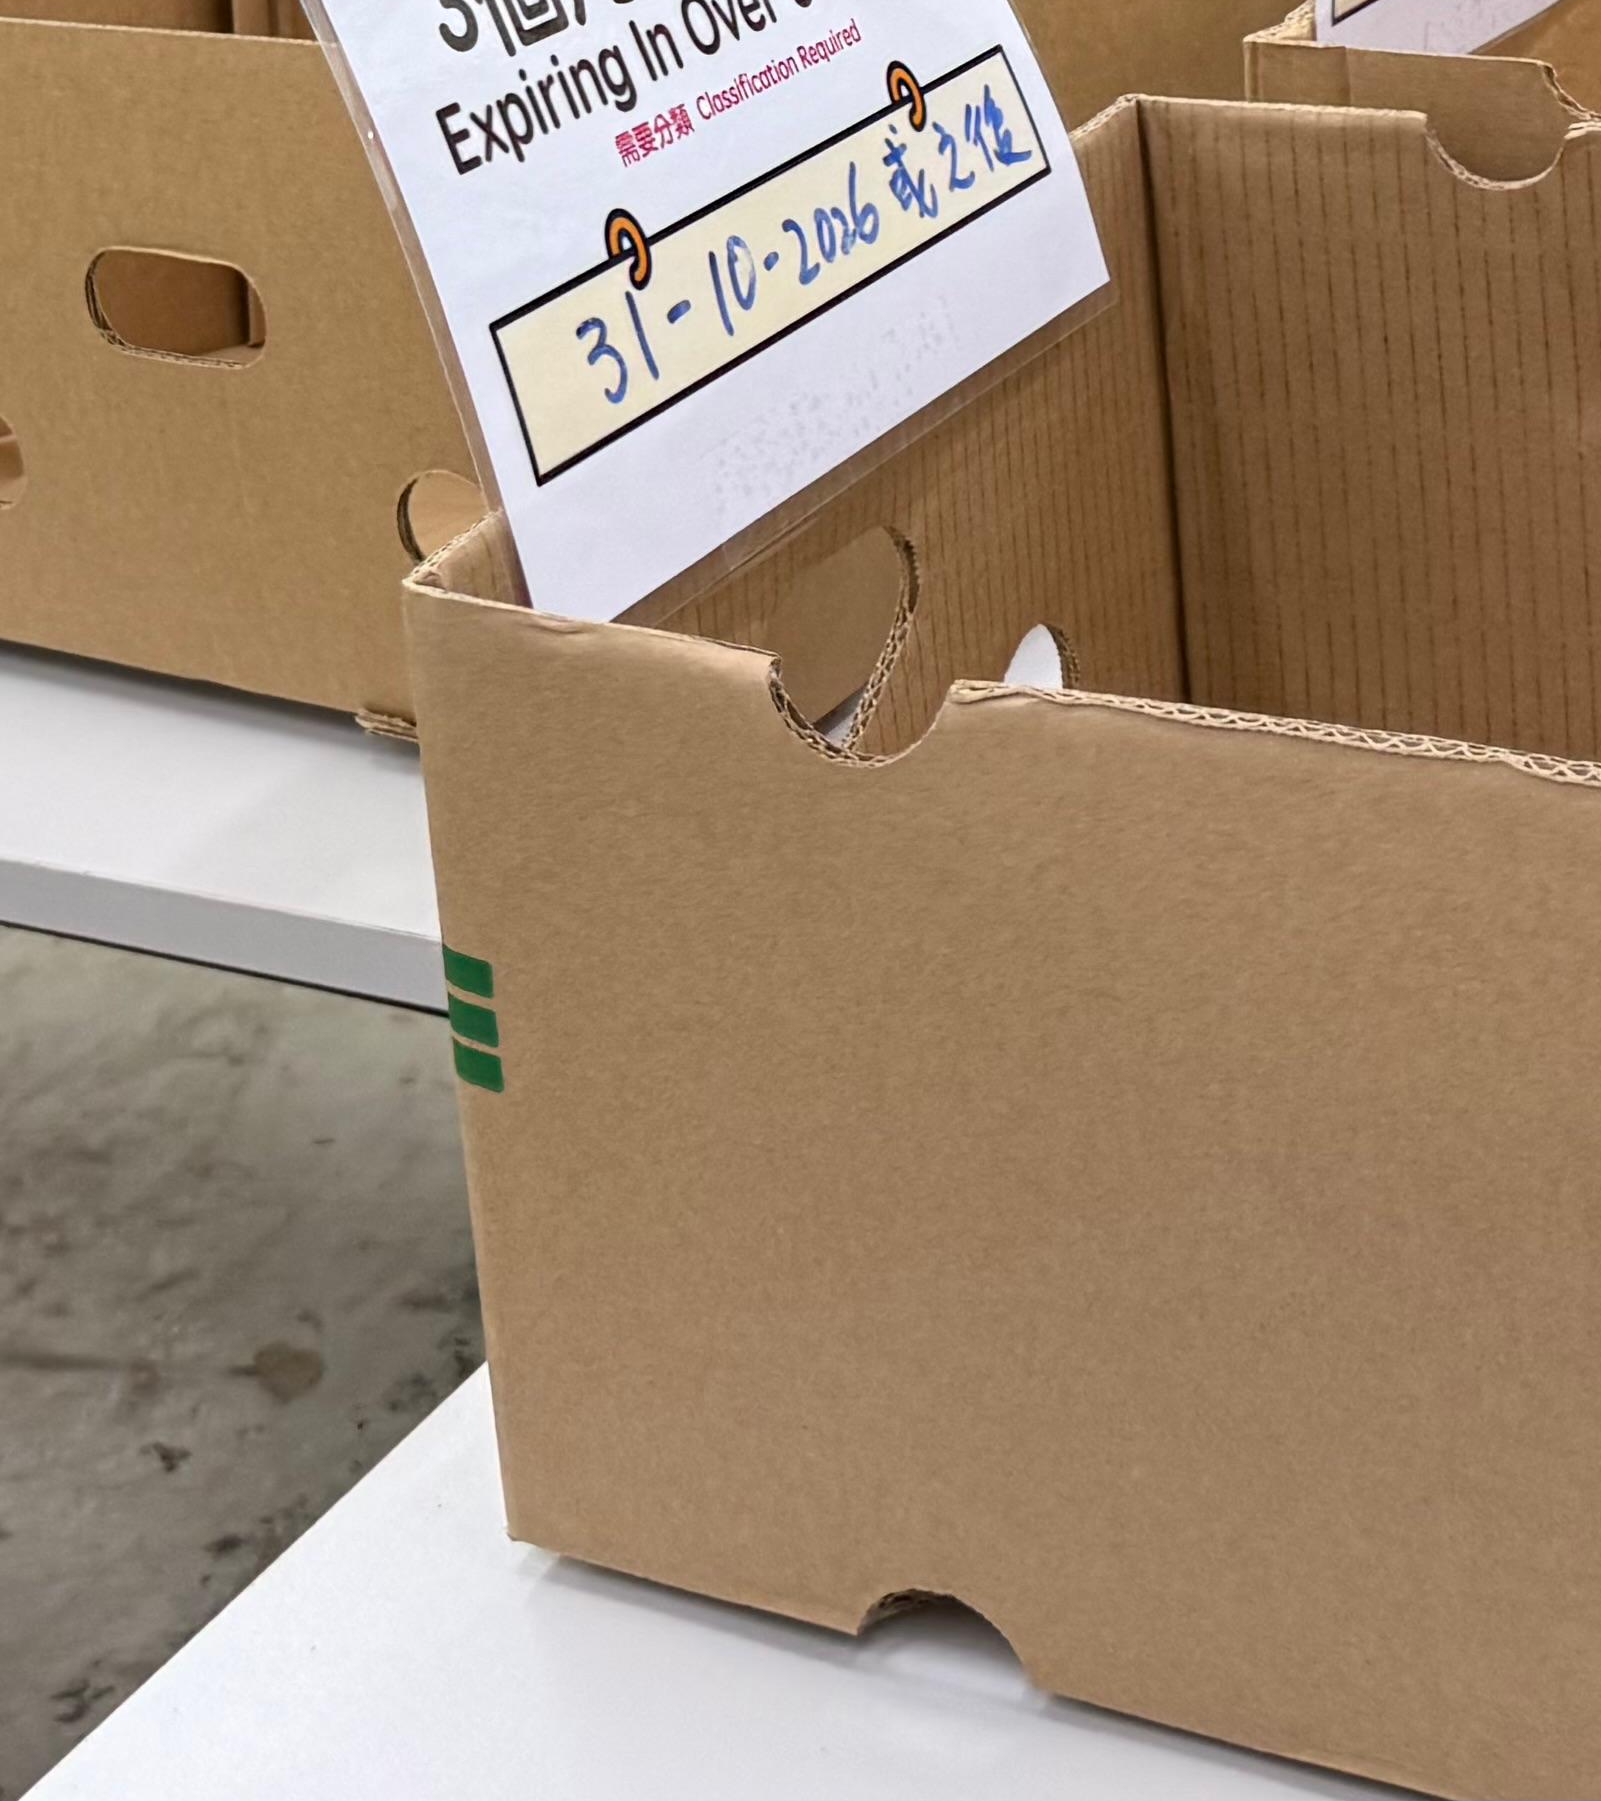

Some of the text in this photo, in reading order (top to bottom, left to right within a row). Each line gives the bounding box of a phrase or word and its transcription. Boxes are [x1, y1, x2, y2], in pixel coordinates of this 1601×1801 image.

[435, 41, 638, 175] Expiring
[629, 19, 685, 83] In
[614, 17, 862, 169] 需要分類 Classification Required
